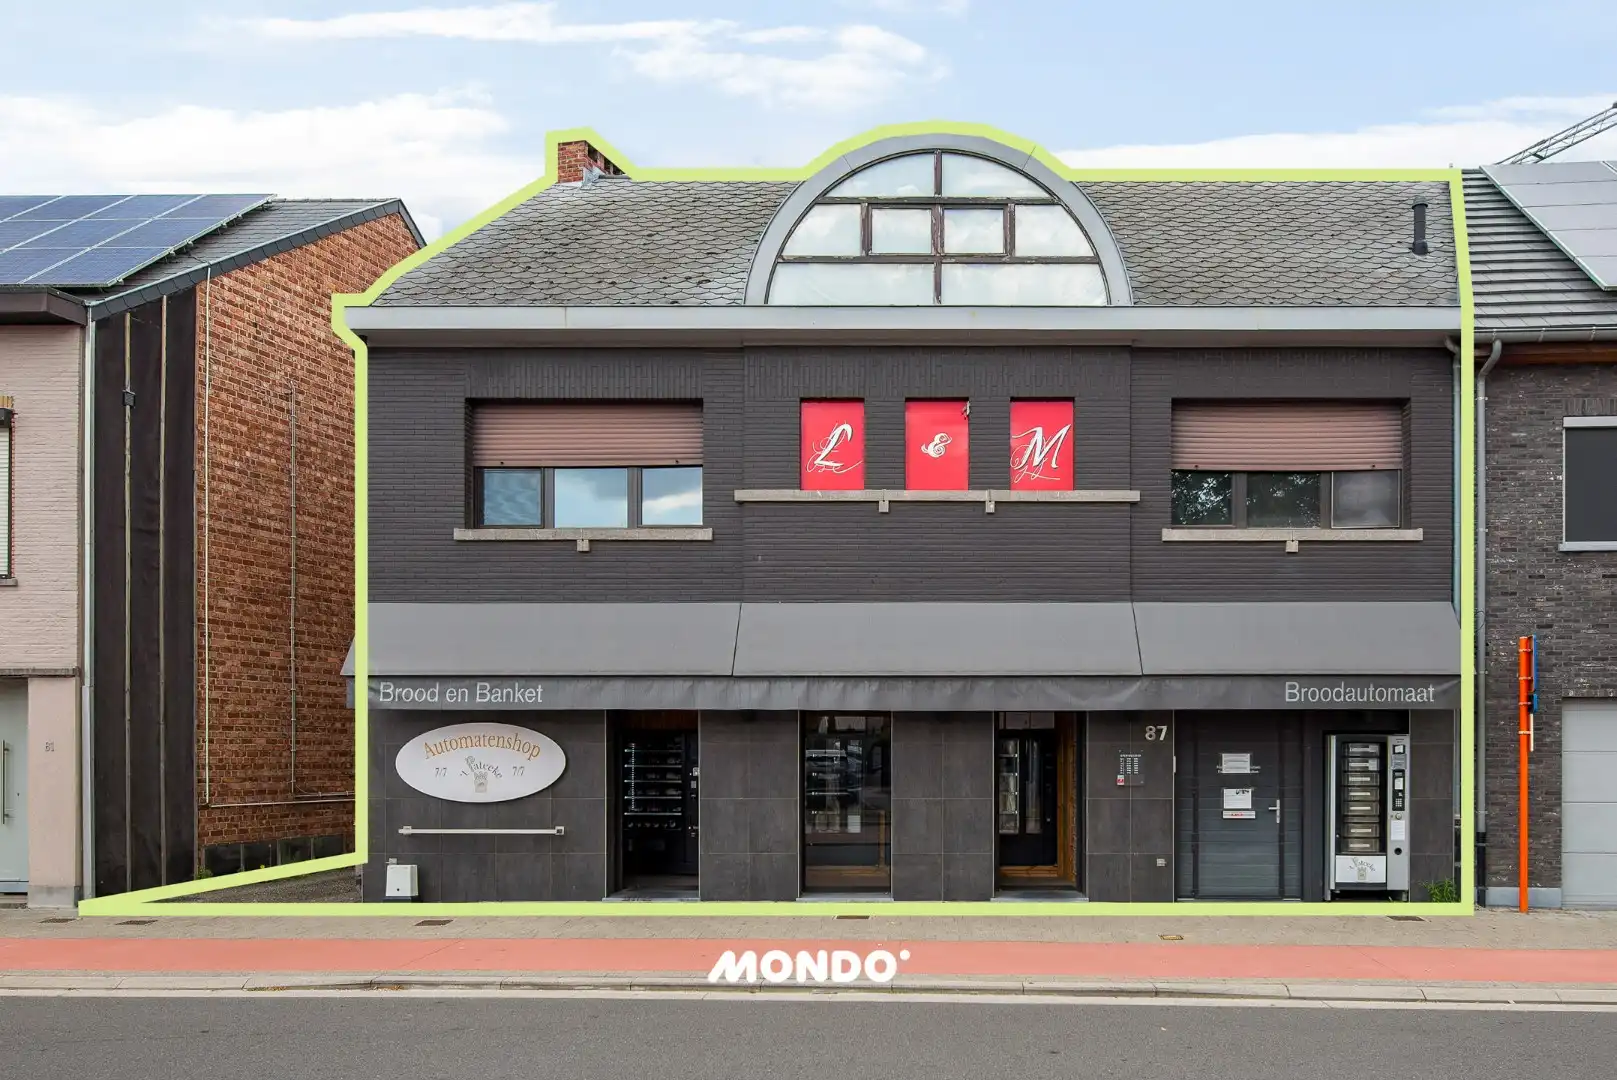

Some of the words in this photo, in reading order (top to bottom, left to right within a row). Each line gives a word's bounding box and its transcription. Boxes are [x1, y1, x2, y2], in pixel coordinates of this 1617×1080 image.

[806, 420, 863, 473] L
[921, 433, 952, 457] &
[1010, 424, 1071, 483] M
[379, 682, 439, 703] Brood
[446, 687, 469, 703] en
[476, 682, 543, 703] Banket
[1285, 681, 1435, 703] Broodautomaat
[1145, 725, 1168, 741] 87
[424, 733, 541, 761] Automatenshop
[435, 767, 447, 777] 7/7
[512, 766, 525, 777] 7/7
